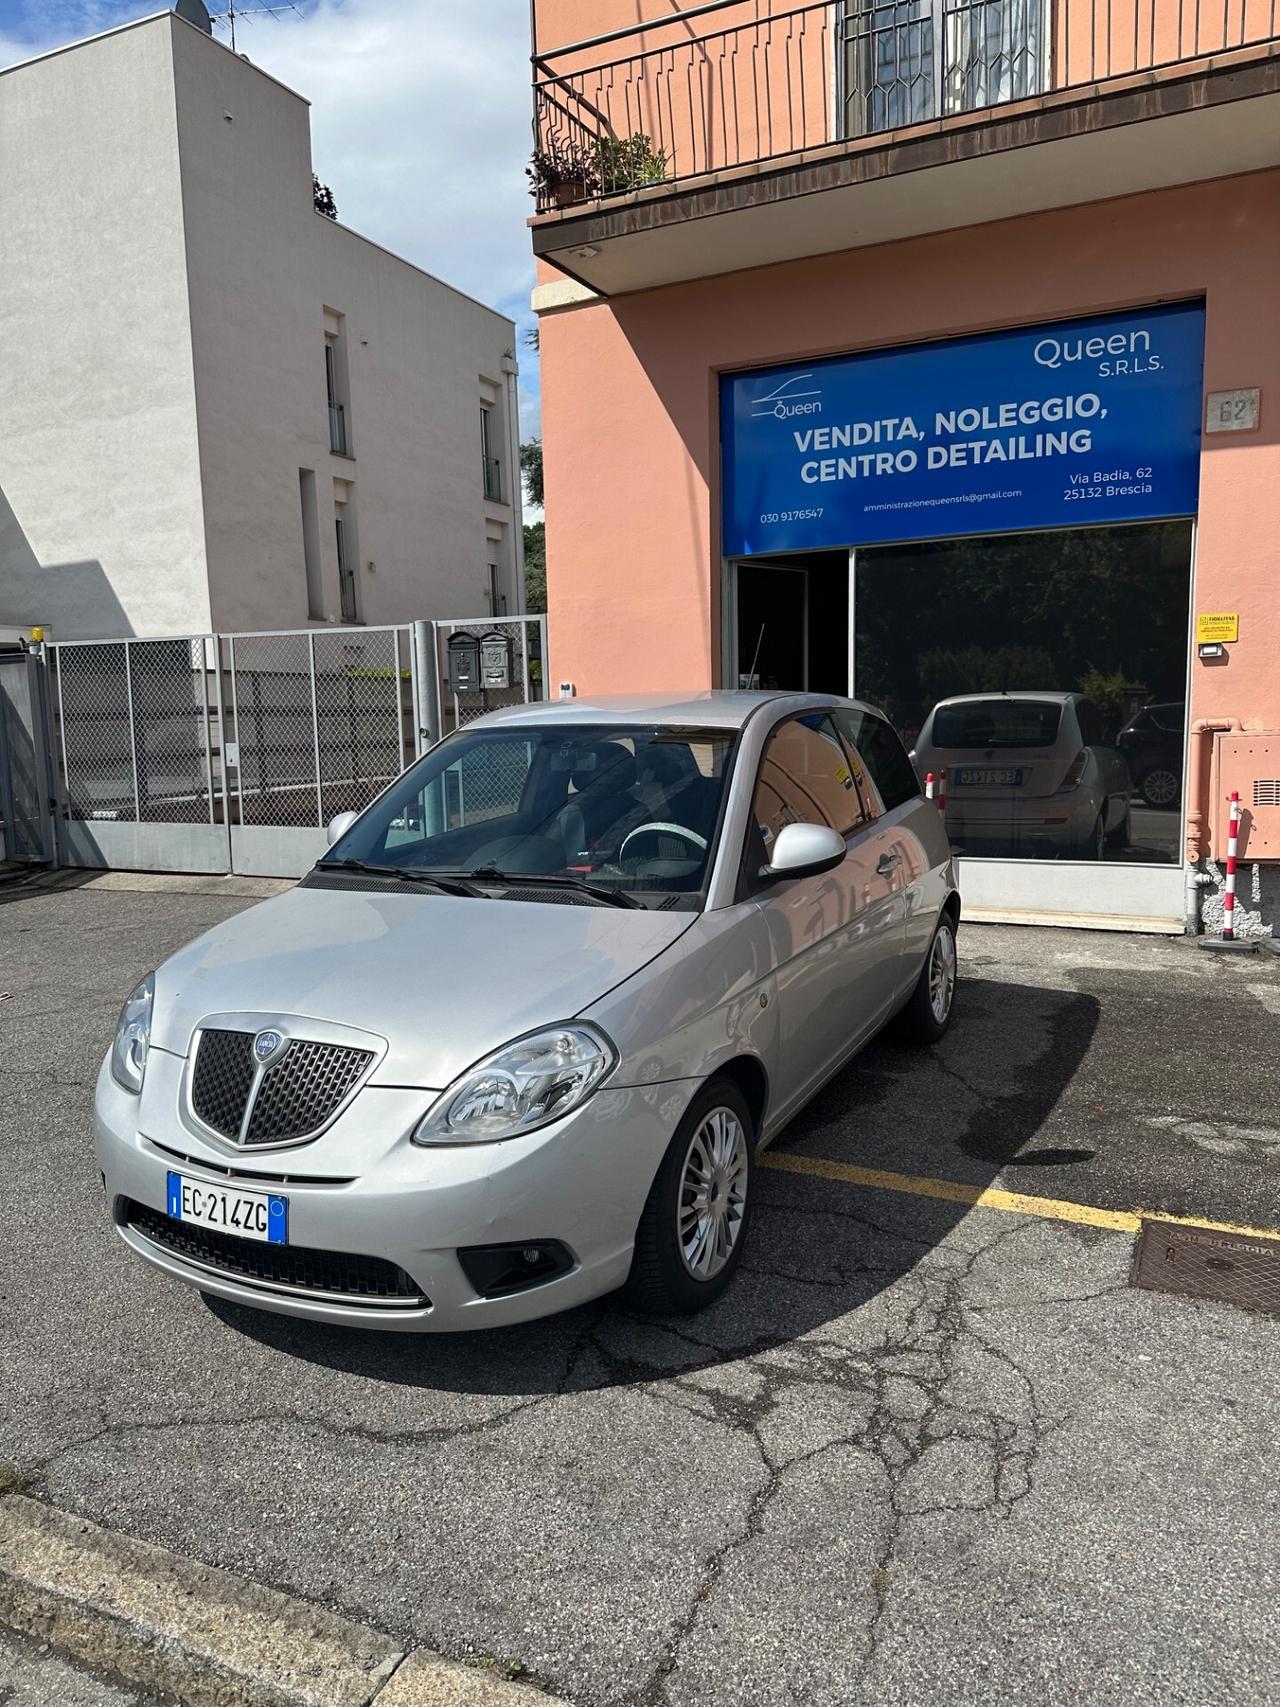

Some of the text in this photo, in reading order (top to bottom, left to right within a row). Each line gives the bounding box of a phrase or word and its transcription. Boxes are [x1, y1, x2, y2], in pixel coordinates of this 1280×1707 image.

[1034, 330, 1150, 368] Queen
[1099, 355, 1164, 377] S.R.L.S.
[774, 401, 822, 419] Queen
[793, 393, 1108, 453] VENDITA, NOLEGGIO,
[800, 429, 1092, 483] CENTRO DETAILING
[1070, 467, 1153, 484] Via Badia, 62
[863, 489, 1022, 512] amministrazionequeensrls@gmail.com
[1063, 482, 1152, 500] 25132 Brescia
[760, 508, 824, 525] 030 9176547
